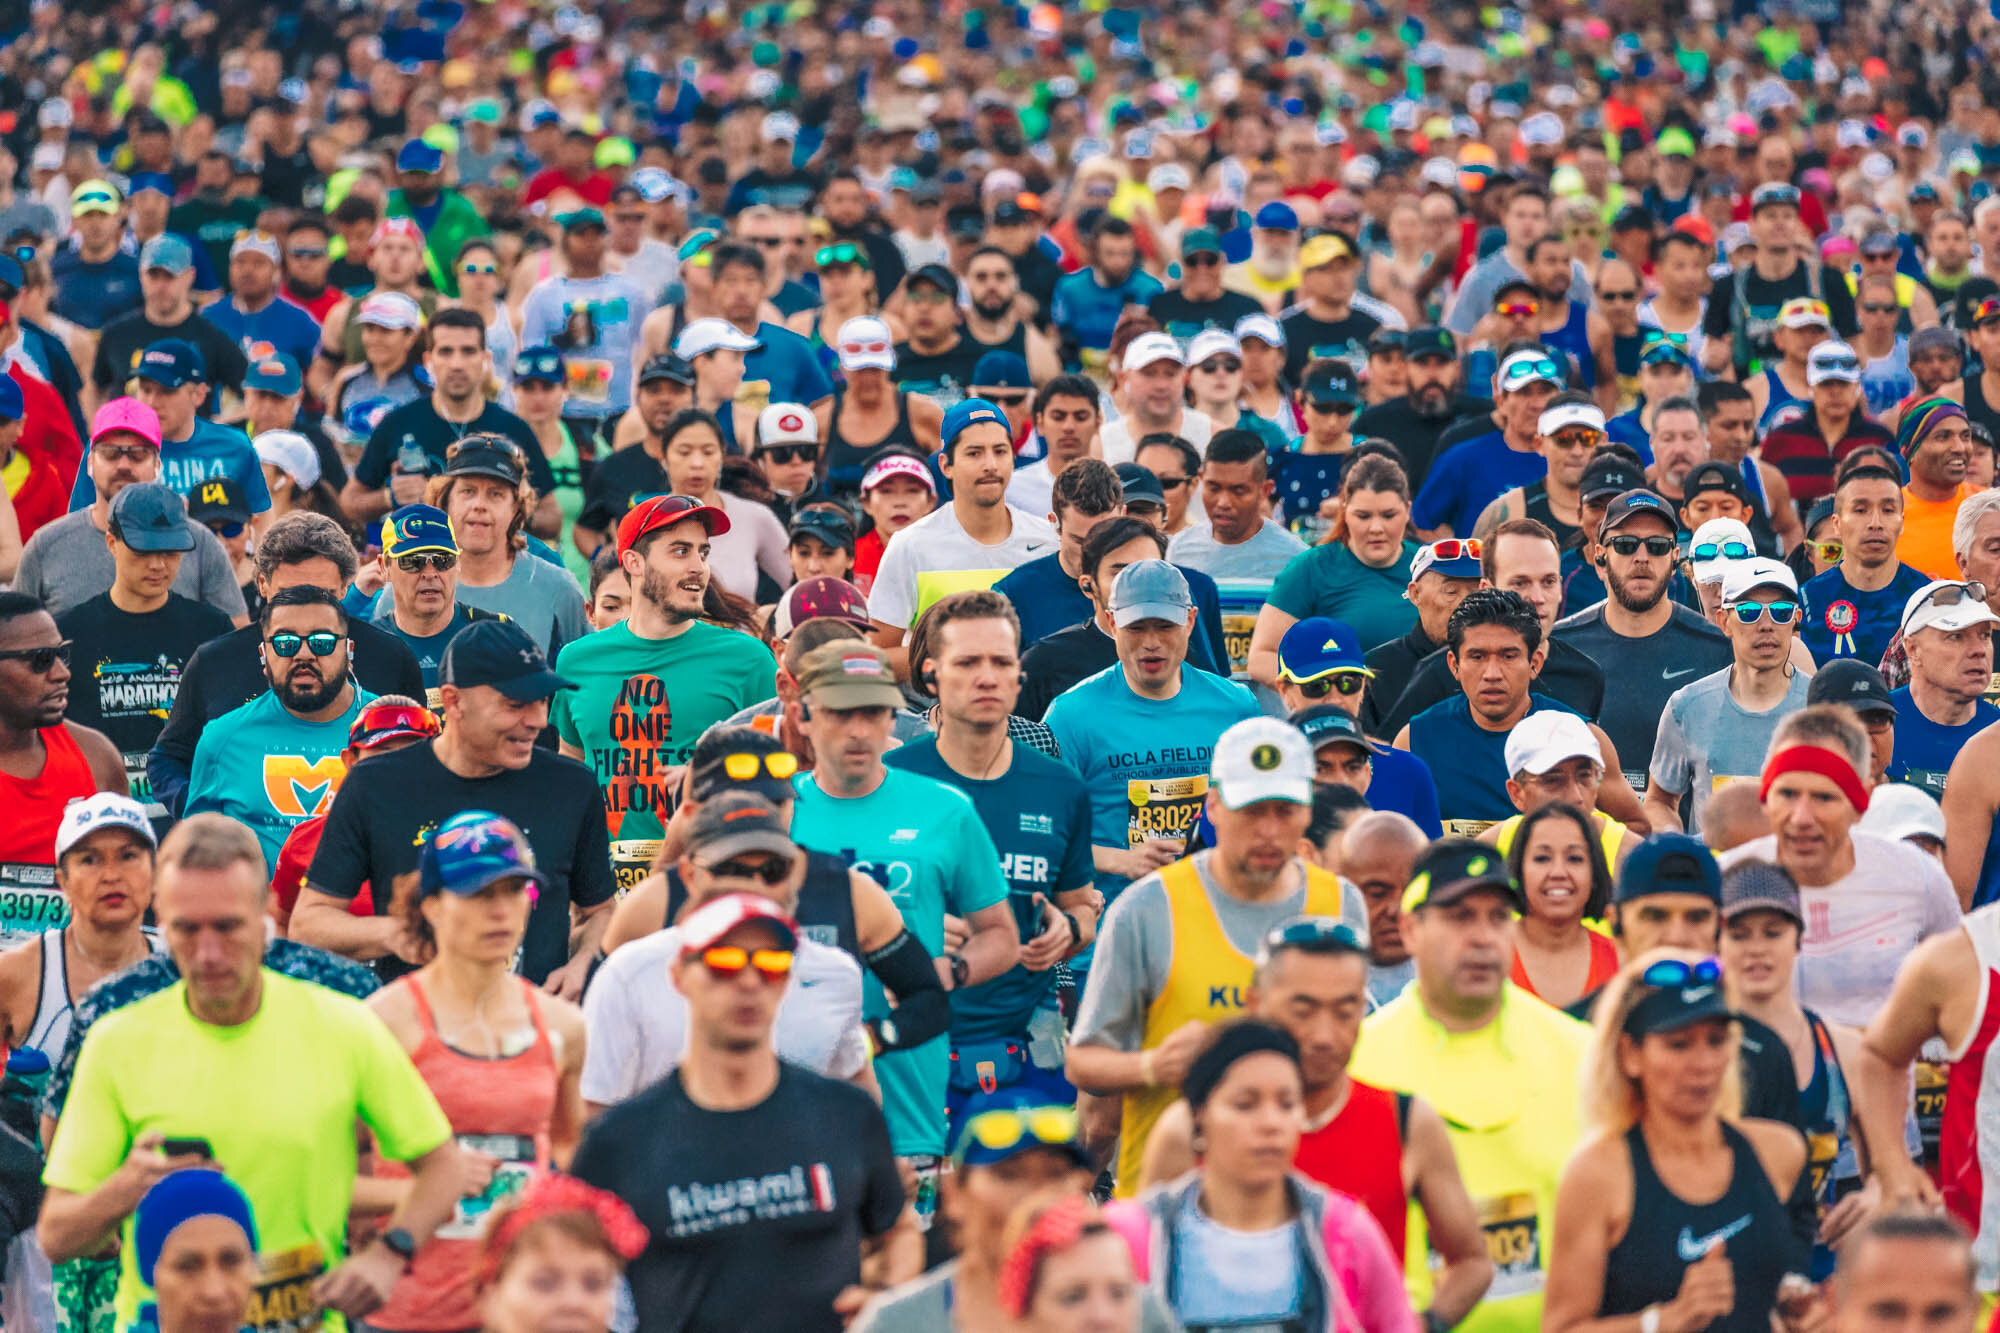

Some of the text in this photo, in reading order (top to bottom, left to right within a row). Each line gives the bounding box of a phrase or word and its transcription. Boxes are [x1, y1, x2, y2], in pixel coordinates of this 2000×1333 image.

[619, 679, 665, 706] NO
[609, 712, 672, 742] ONE
[1108, 745, 1215, 768] UCLA FIELDI
[1111, 770, 1149, 782] SCHOOL
[1167, 764, 1200, 776] PUBLIC
[0, 893, 63, 922] 3973
